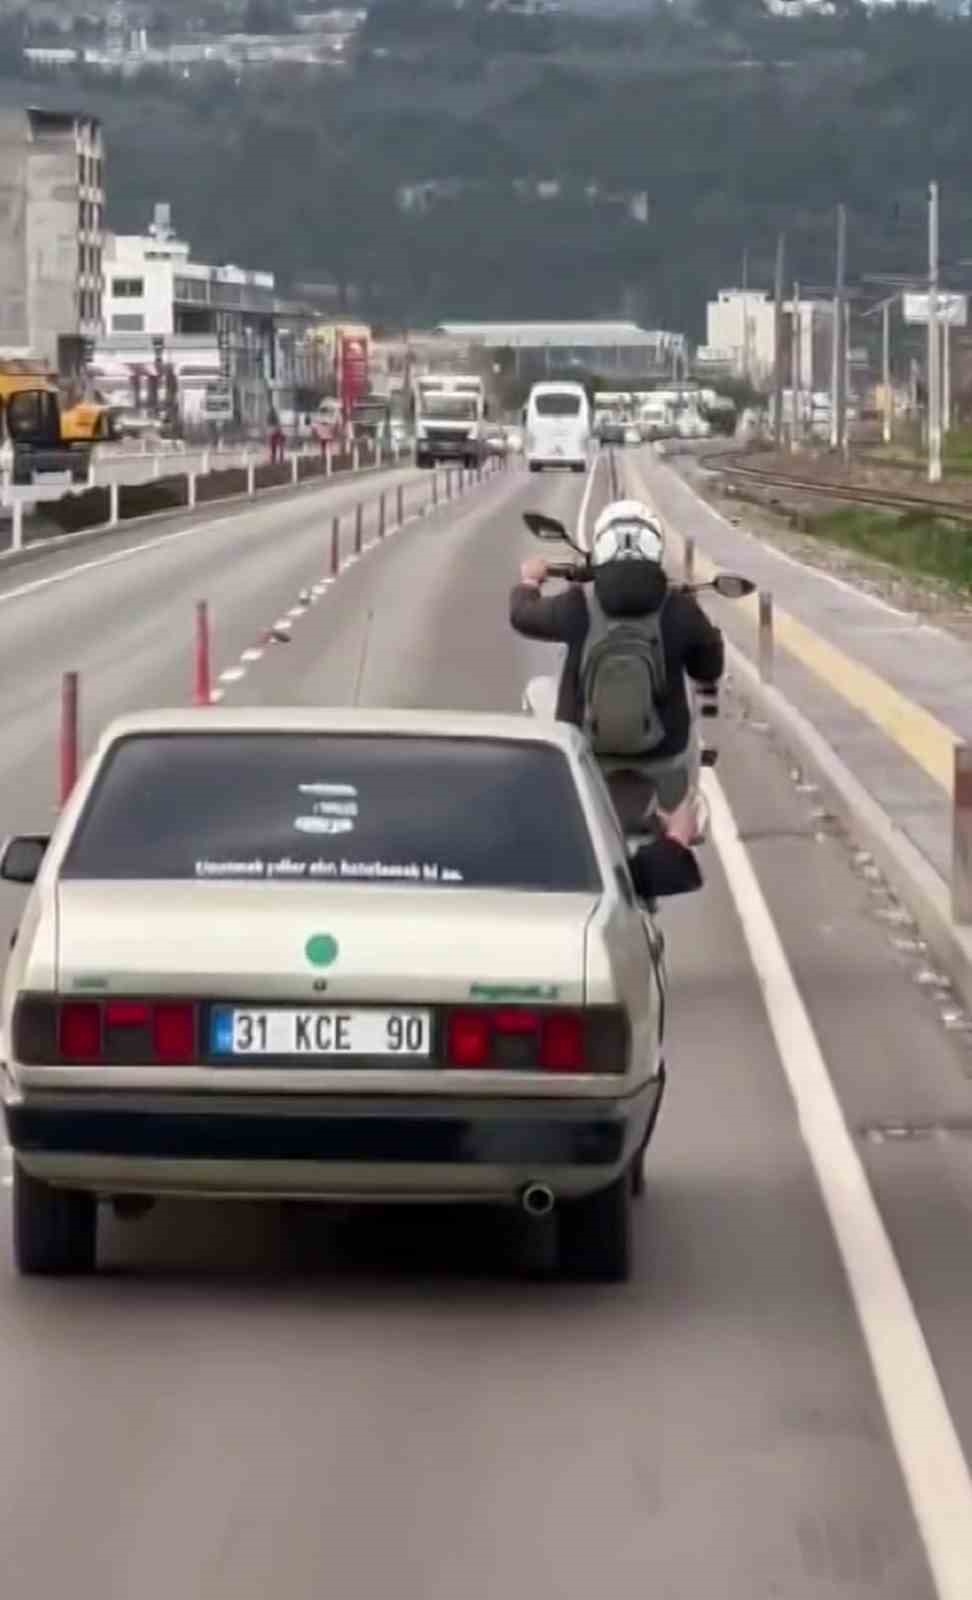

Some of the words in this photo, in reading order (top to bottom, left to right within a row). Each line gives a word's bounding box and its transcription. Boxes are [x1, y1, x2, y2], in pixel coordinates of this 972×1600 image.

[236, 1015, 268, 1051] 31
[294, 1015, 352, 1051] KCE
[386, 1016, 423, 1051] 90
